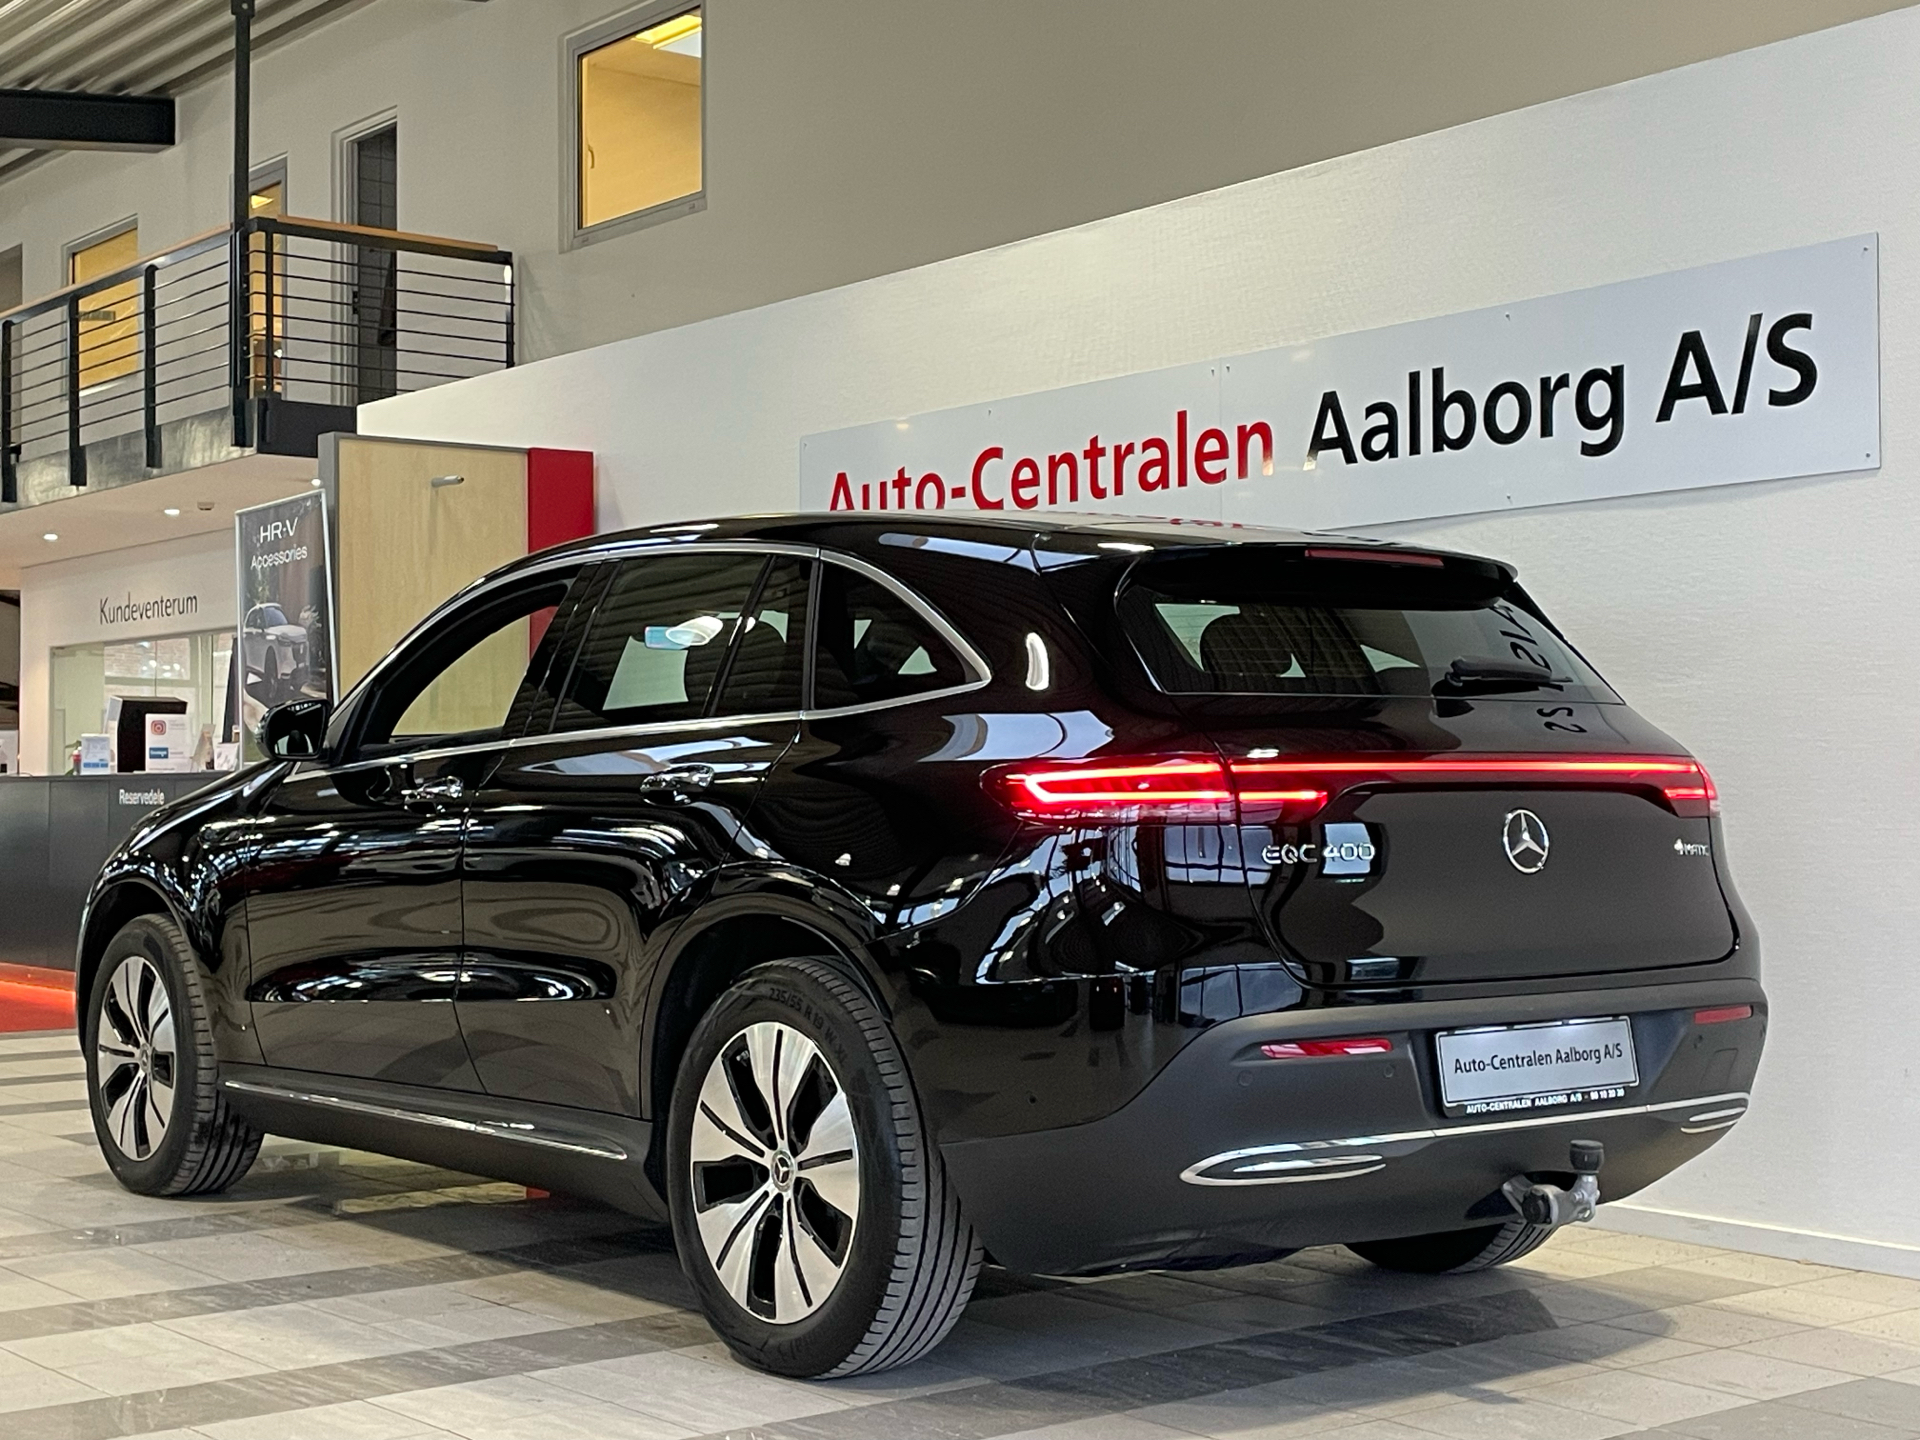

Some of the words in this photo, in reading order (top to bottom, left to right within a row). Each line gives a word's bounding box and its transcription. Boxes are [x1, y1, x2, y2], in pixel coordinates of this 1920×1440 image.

[829, 410, 1274, 511] Auto-Centralen
[1303, 364, 1626, 471] Aalborg
[1655, 312, 1819, 423] A/S
[250, 545, 308, 571] Accessories
[100, 591, 198, 625] Kundeventerum
[119, 788, 165, 806] Reservedele
[1261, 843, 1317, 864] EQC
[1323, 842, 1375, 862] 400
[1454, 1050, 1552, 1074] Auto-Centralen
[1555, 1046, 1601, 1065] Aalborg
[1604, 1043, 1623, 1059] A/S
[1466, 1098, 1533, 1114] AUTO-CENTRALEN
[1534, 1095, 1568, 1107] AALBORG
